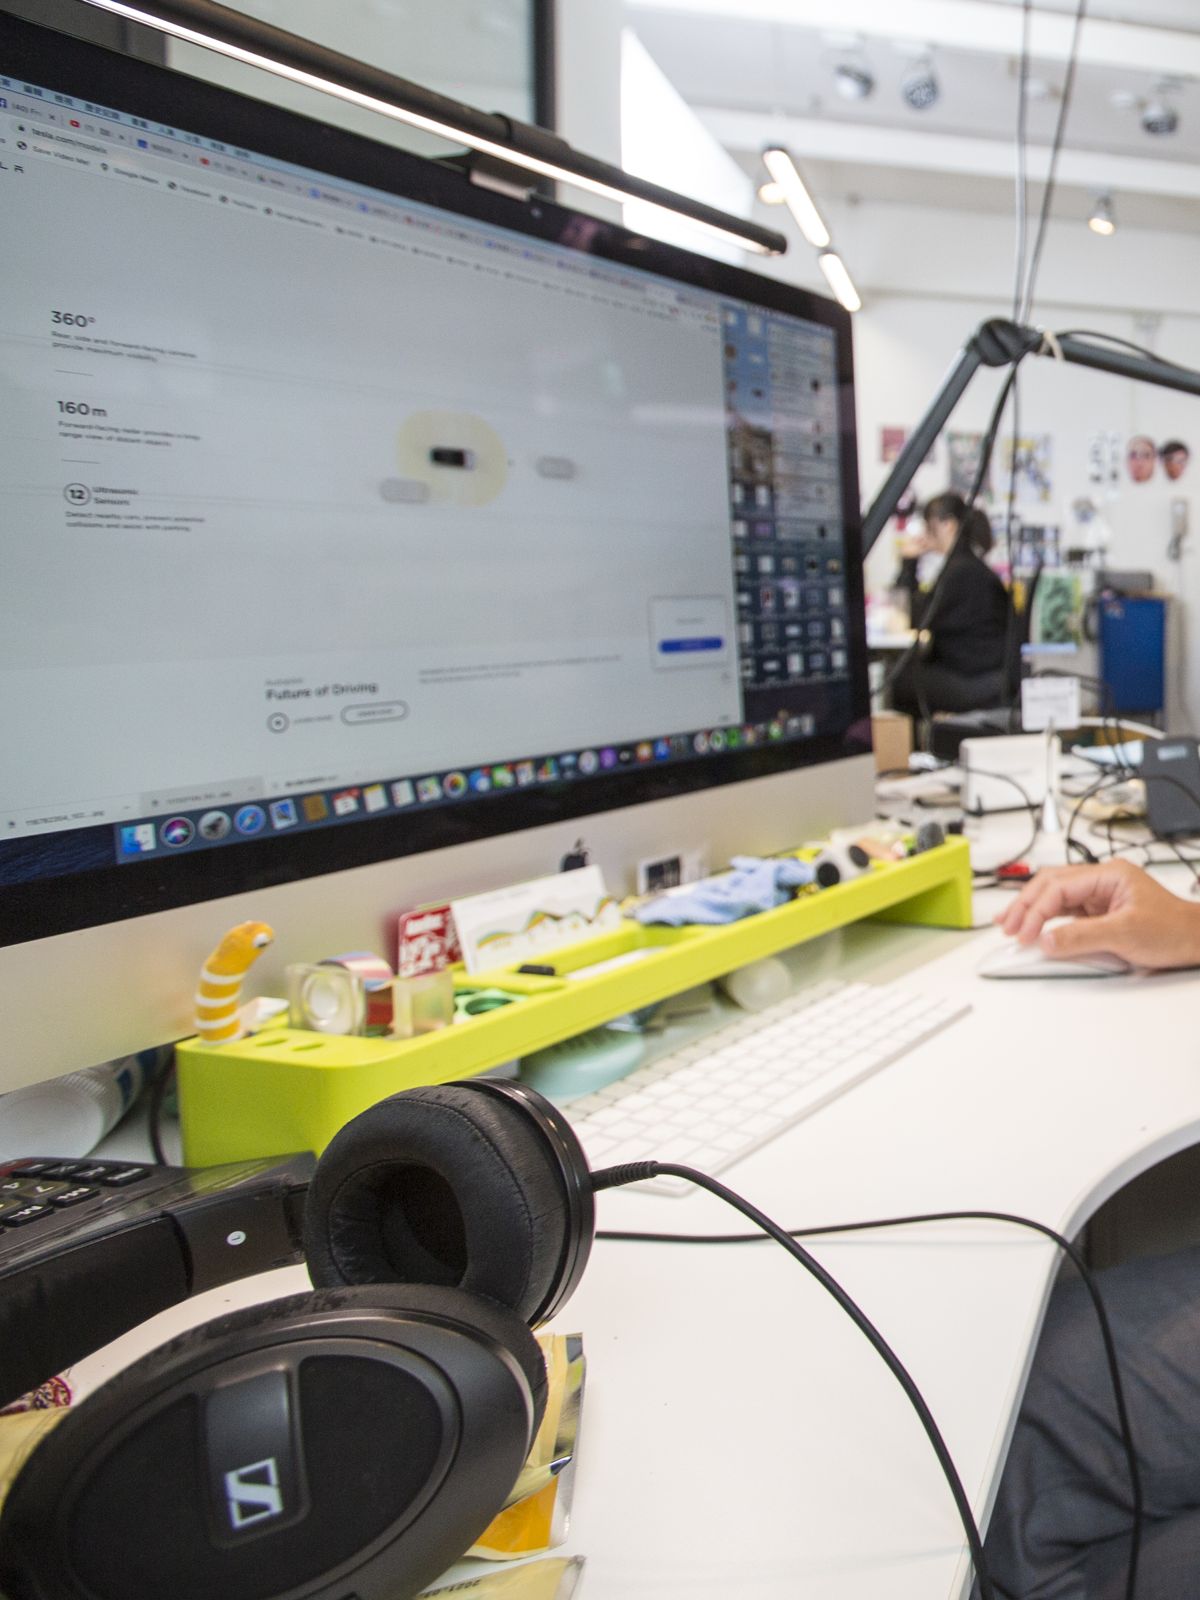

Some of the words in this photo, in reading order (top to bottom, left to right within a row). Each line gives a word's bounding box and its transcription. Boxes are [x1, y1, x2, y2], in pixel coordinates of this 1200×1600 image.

[57, 400, 90, 416] 160
[69, 489, 85, 500] 12
[266, 687, 312, 701] Future
[314, 685, 329, 697] of
[331, 682, 379, 697] Driving
